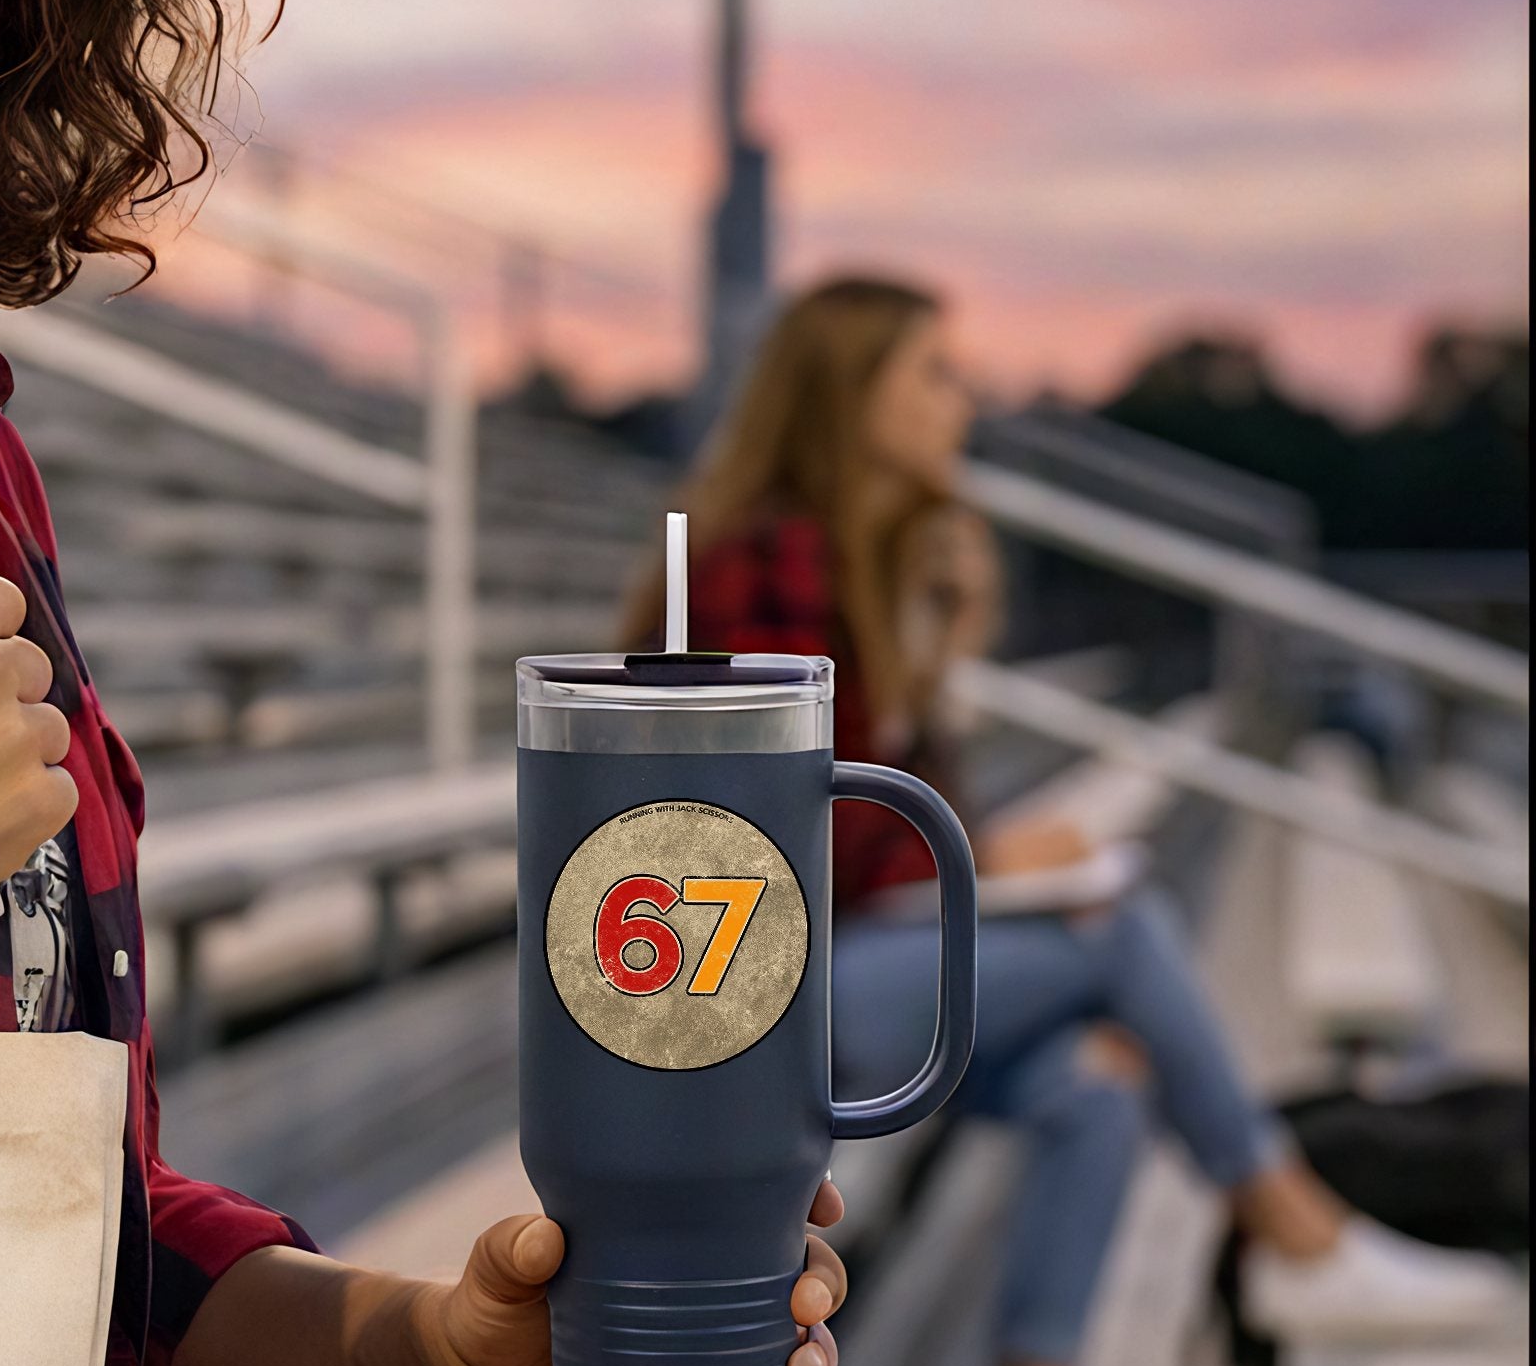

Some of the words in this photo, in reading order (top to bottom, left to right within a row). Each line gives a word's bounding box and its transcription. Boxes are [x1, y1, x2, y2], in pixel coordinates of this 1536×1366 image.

[619, 808, 653, 825] RUNNING
[655, 805, 674, 813] WITH
[677, 805, 697, 813] JACK
[593, 873, 768, 997] 67
